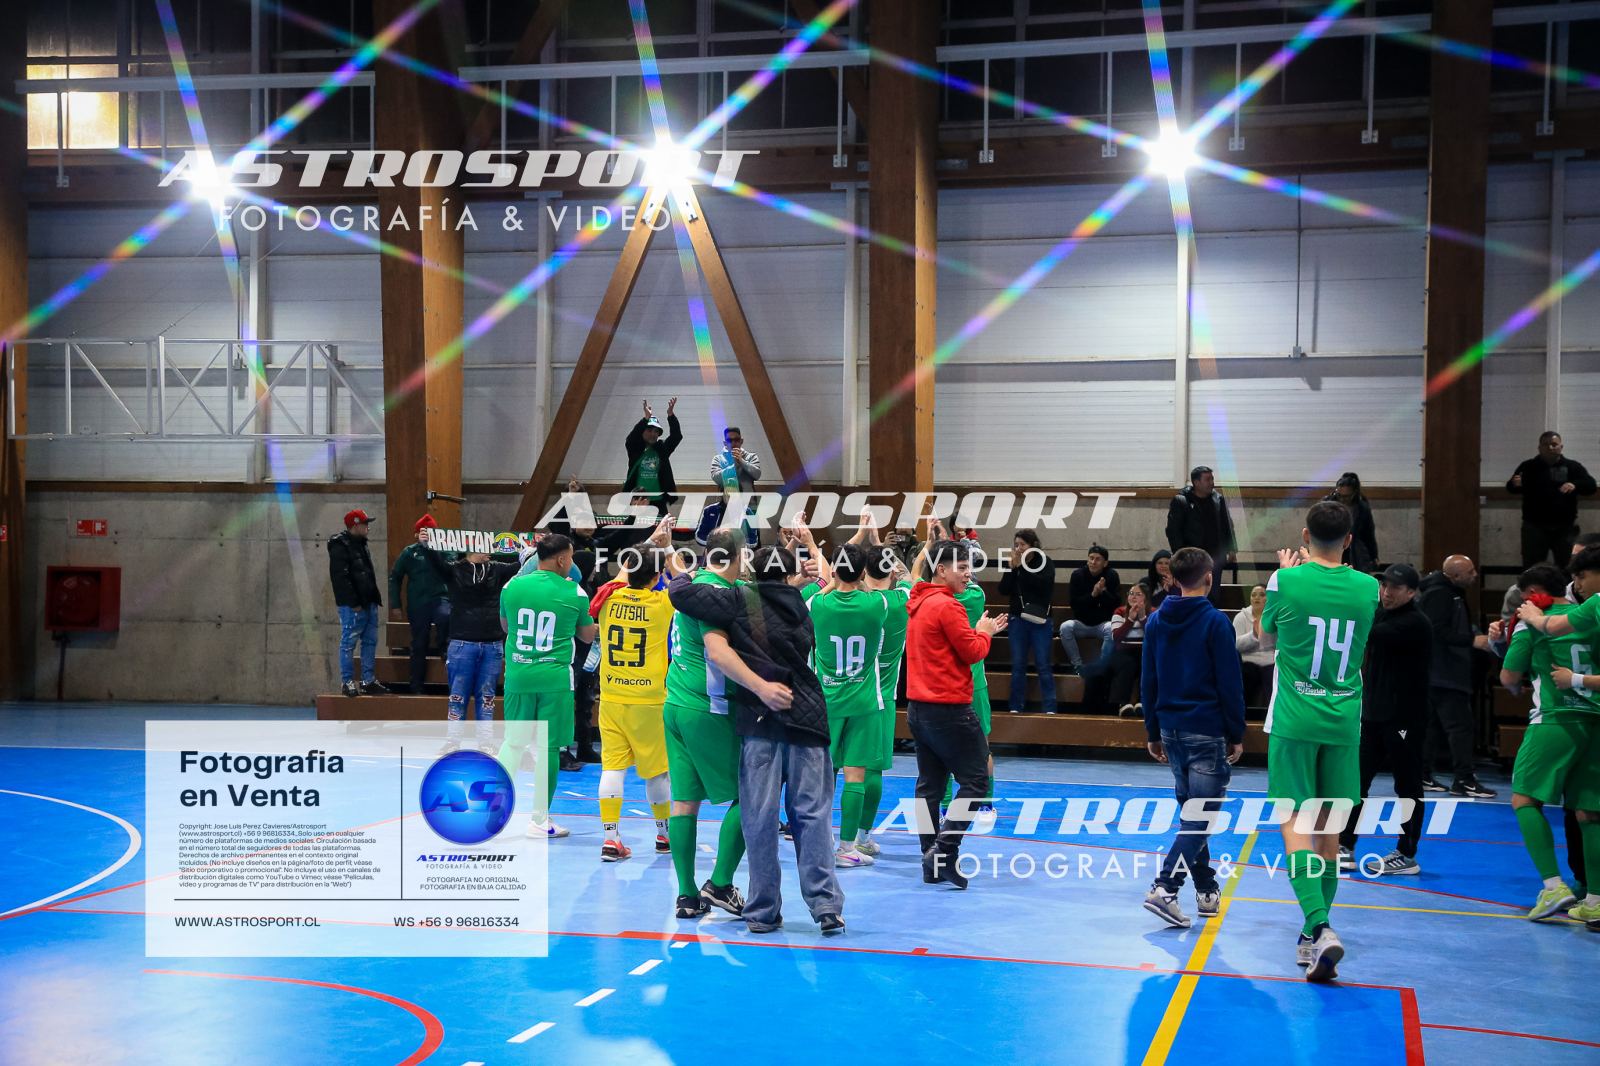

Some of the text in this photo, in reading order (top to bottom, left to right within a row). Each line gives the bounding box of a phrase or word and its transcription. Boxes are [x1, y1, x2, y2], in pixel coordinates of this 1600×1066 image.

[516, 608, 556, 652] 20
[609, 604, 650, 622] FUTSAL
[608, 624, 646, 668] 23
[830, 636, 866, 677] 18
[1308, 616, 1356, 682] 14
[614, 677, 652, 686] macron
